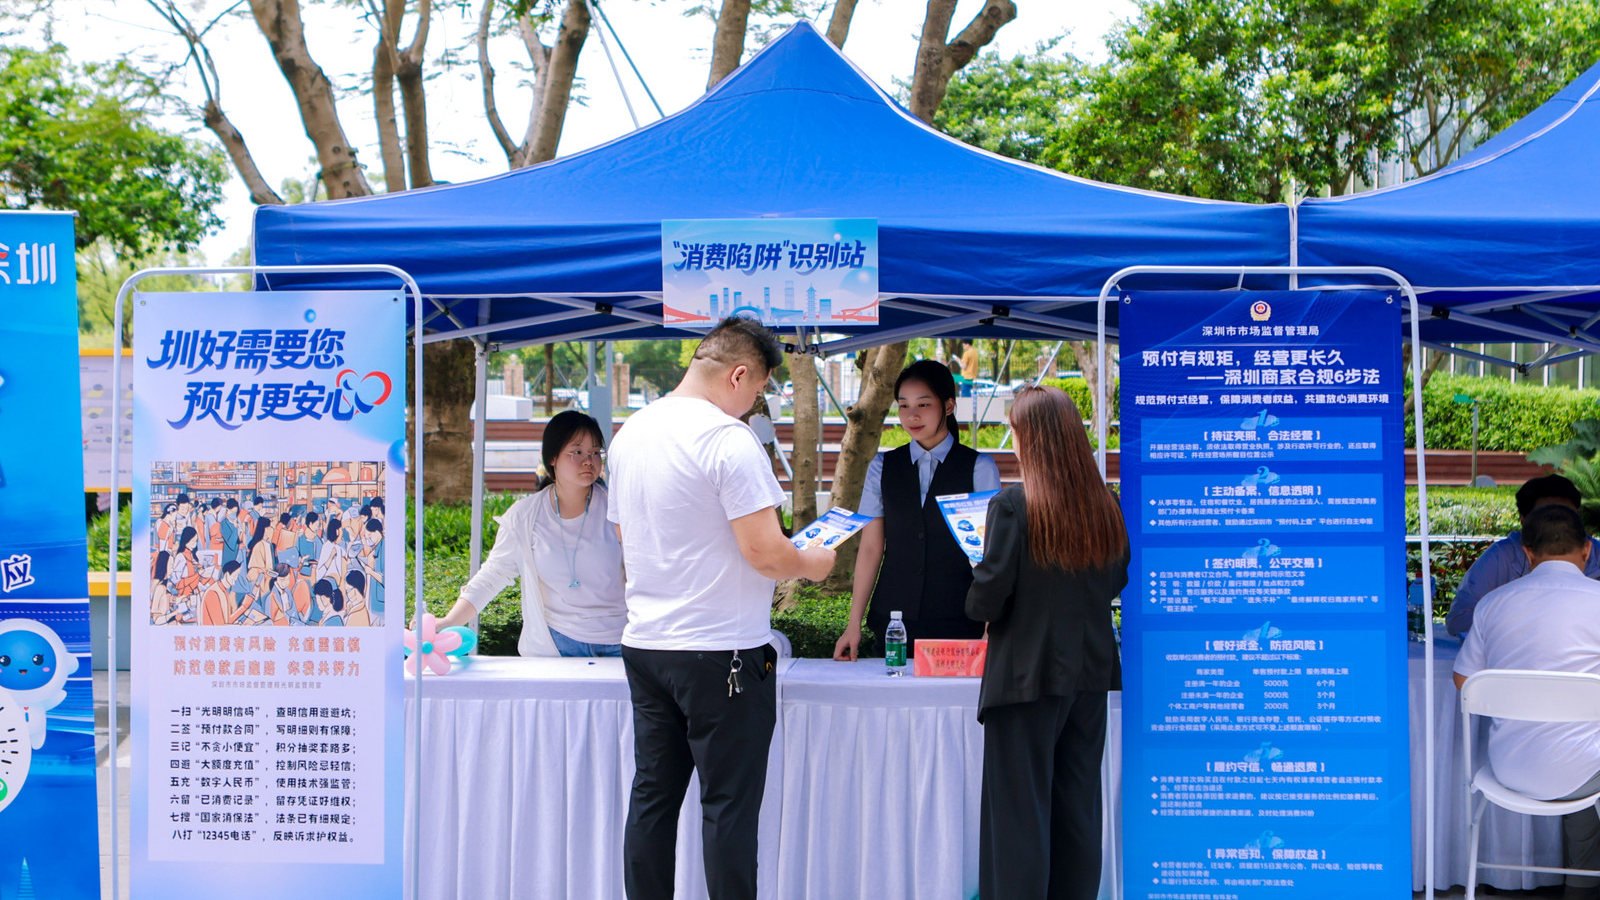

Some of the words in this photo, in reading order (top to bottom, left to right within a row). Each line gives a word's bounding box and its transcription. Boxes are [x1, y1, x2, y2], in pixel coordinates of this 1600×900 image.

[0, 243, 56, 284] 圳
[672, 239, 867, 276] “消费陷阱”识别站
[1203, 326, 1319, 336] 深圳市市场监督管理局
[147, 328, 346, 375] 圳好需要您
[1142, 350, 1344, 366] 预付有规矩，经营更长久
[1188, 368, 1380, 385] ——深圳商家合规6步法
[166, 380, 374, 431] 预付更安心
[1135, 394, 1389, 405] 规范预付式经营，保障消费者权益，共建放心消费环境
[1, 553, 36, 593] 应
[174, 636, 276, 652] 预付消费有风险
[287, 661, 359, 676] 你我共努力
